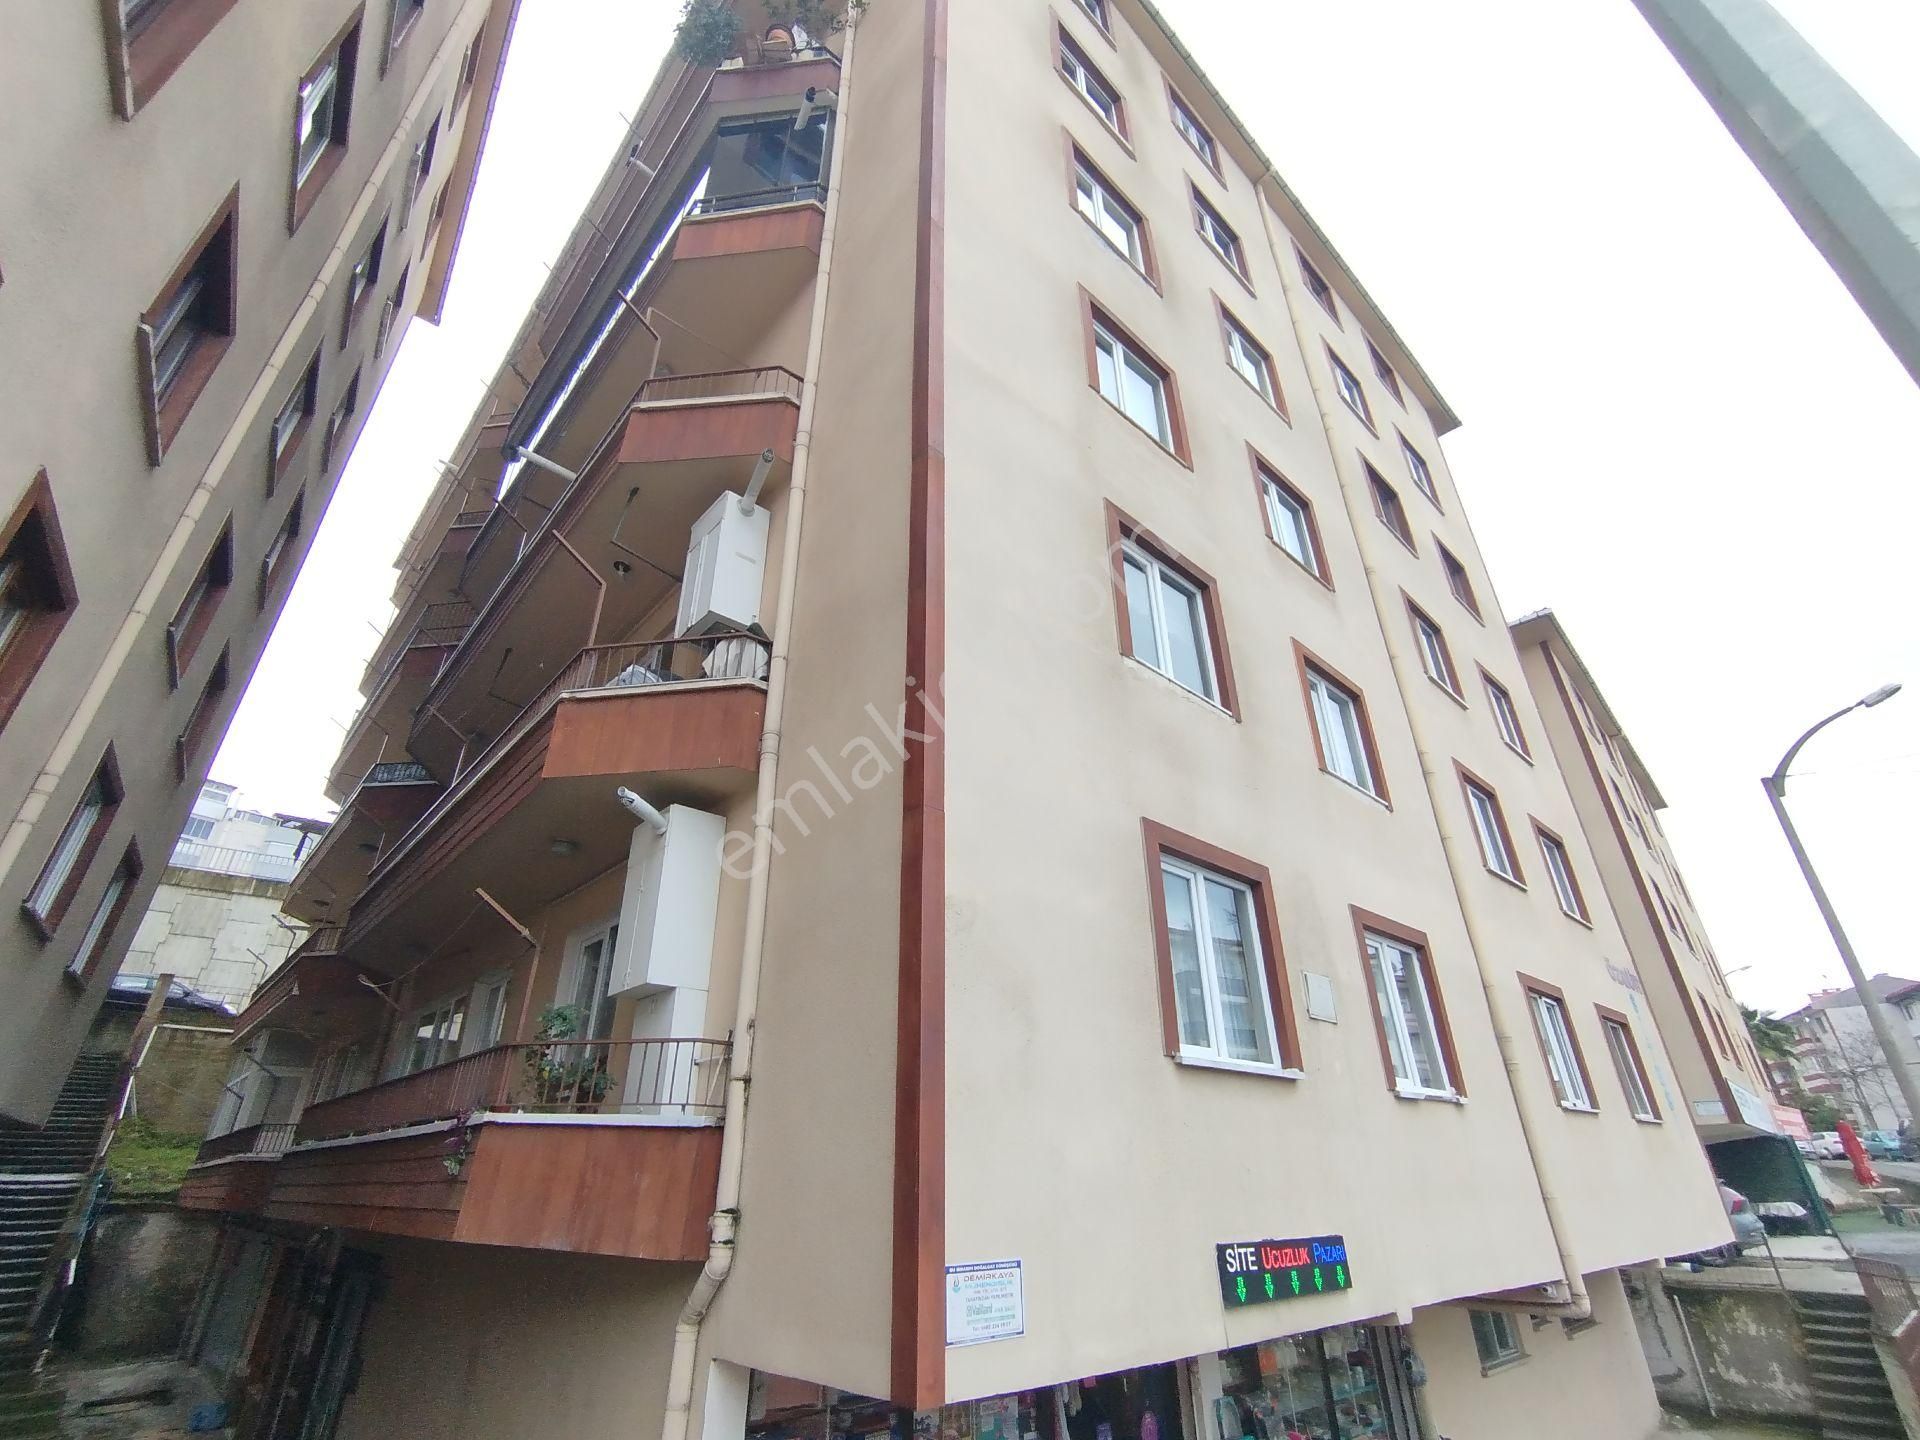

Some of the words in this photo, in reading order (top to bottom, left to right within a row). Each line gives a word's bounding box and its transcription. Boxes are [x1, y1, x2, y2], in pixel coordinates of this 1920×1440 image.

[1225, 1243, 1258, 1272] SİTE
[1262, 1246, 1311, 1269] UCUZLUK
[1312, 1242, 1345, 1263] PAZARI
[963, 1271, 1014, 1282] DEMİRKAYA
